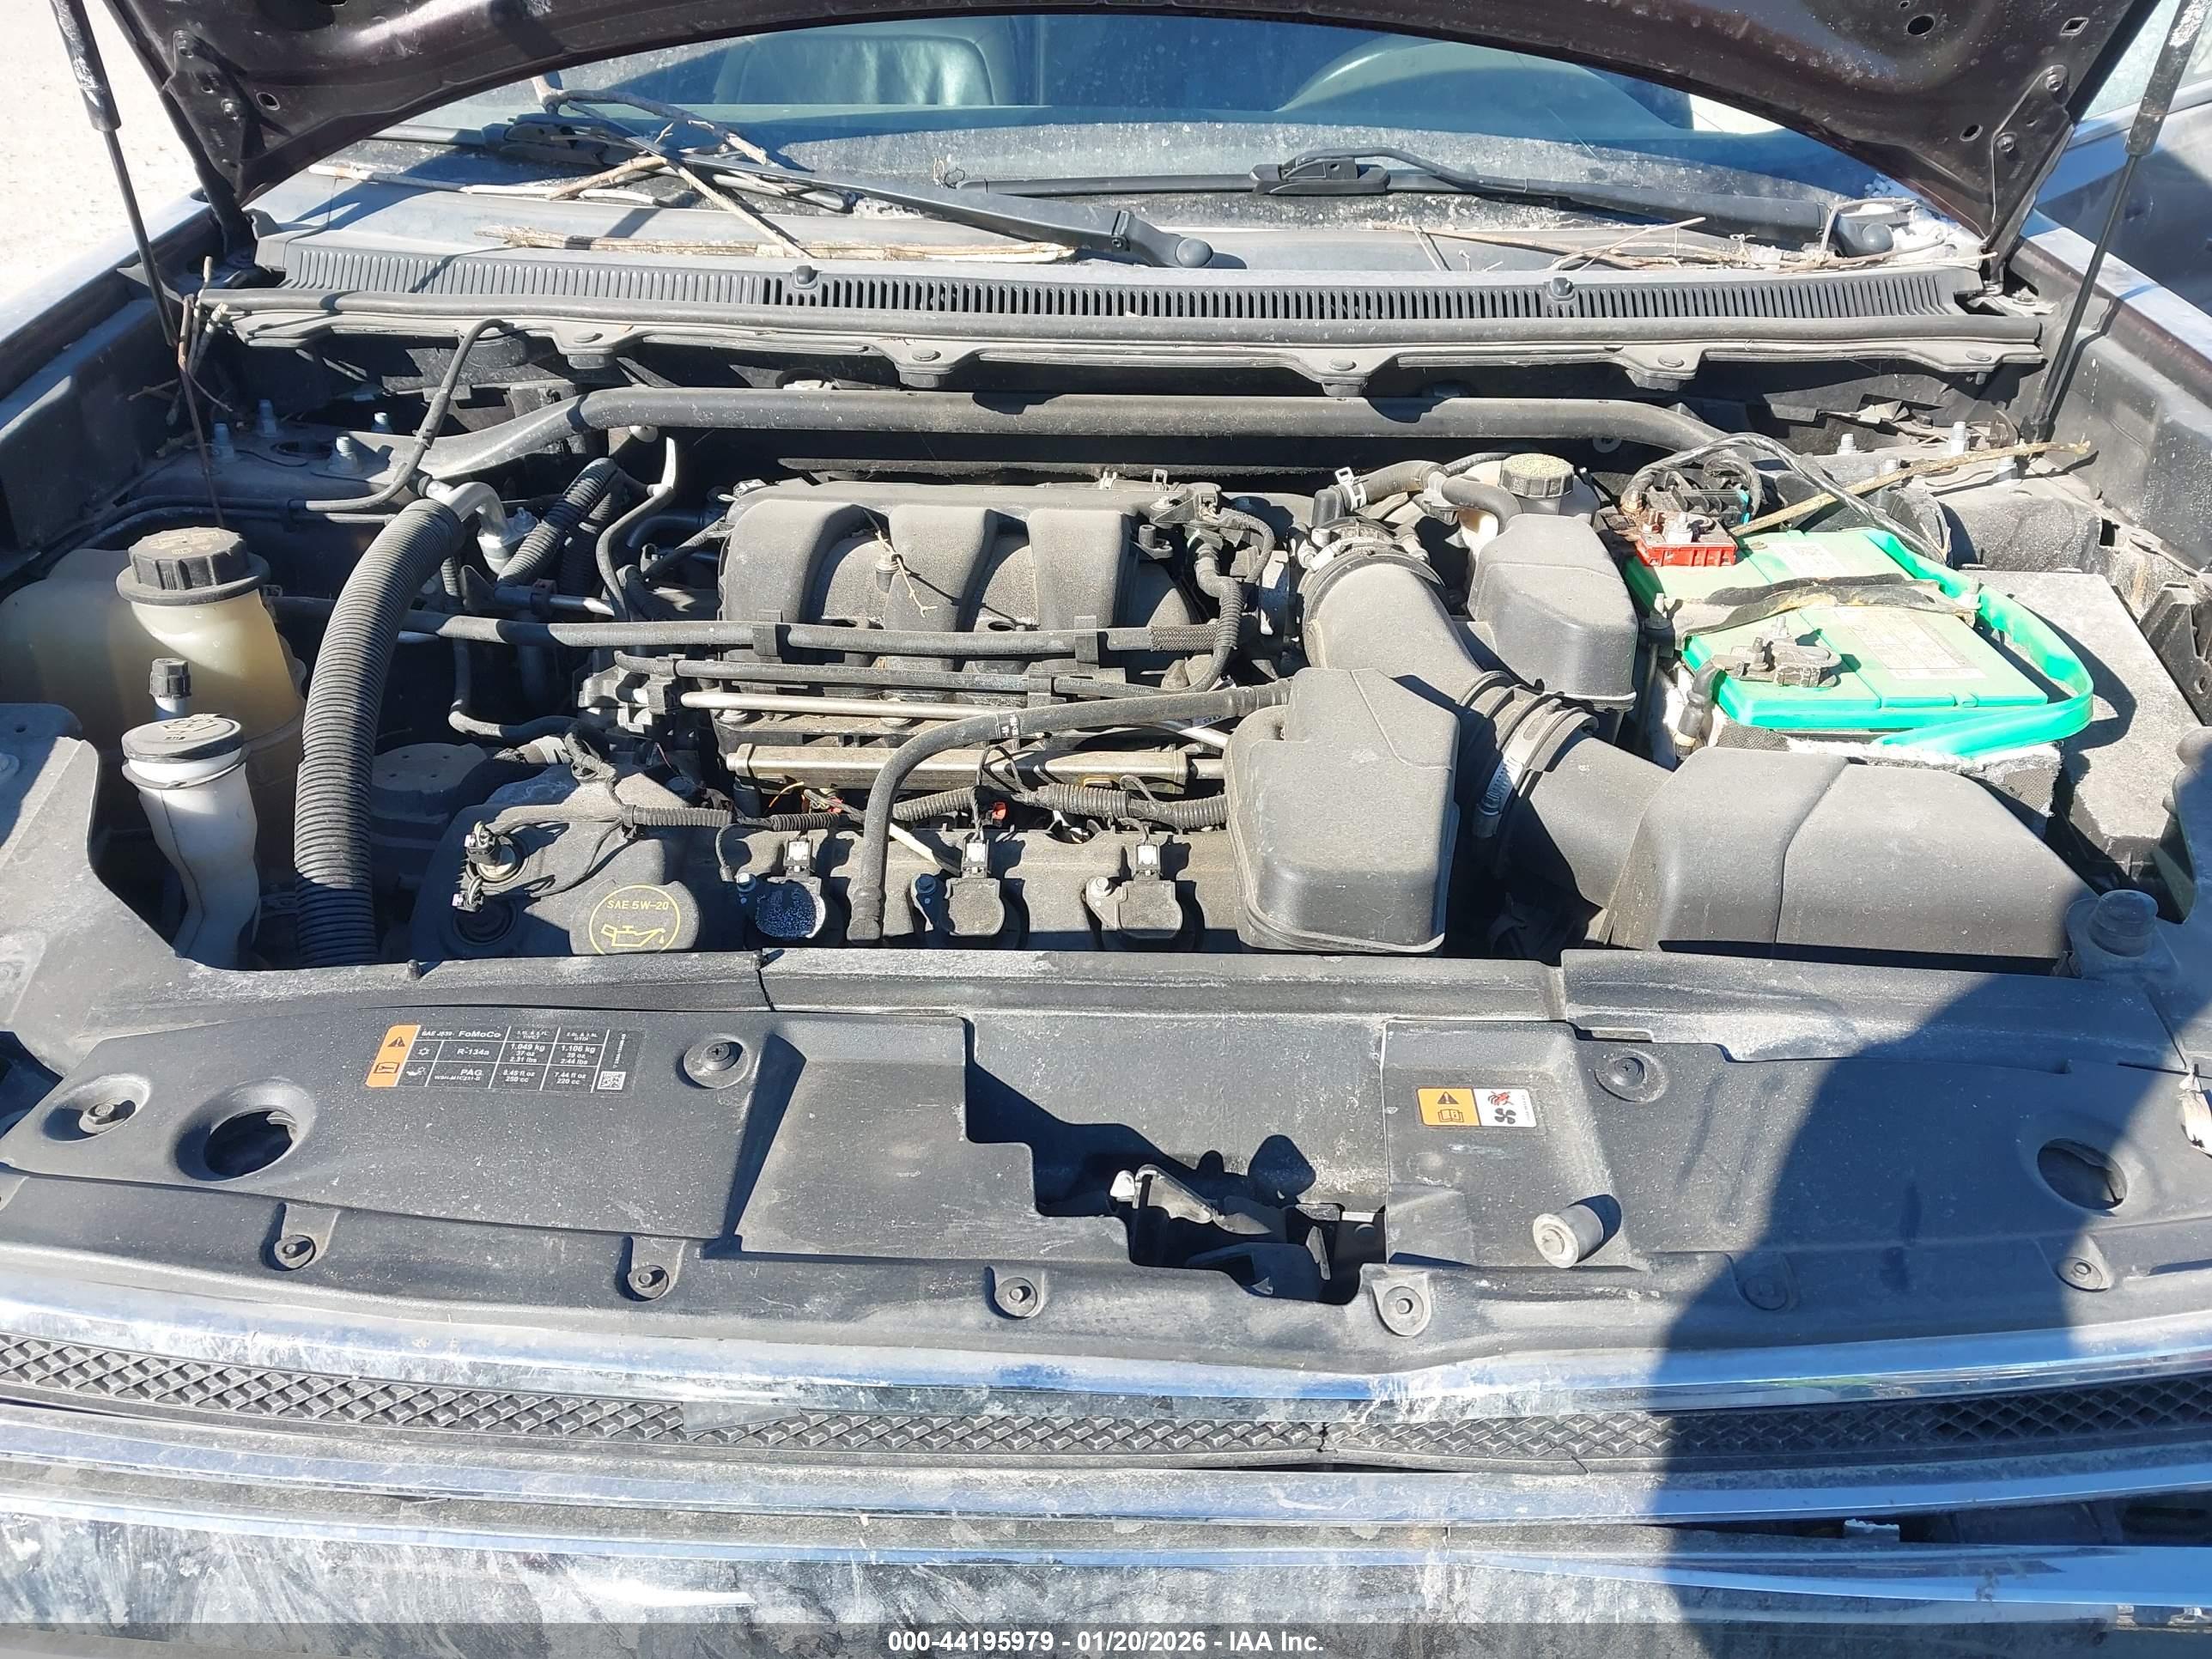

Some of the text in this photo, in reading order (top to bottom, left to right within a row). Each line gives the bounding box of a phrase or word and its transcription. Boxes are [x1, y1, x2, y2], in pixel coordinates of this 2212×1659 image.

[606, 900, 670, 910] SAE 5W-20
[534, 1044, 546, 1053] kg
[561, 1044, 597, 1054] 1.106 kg
[460, 1068, 483, 1077] PAG
